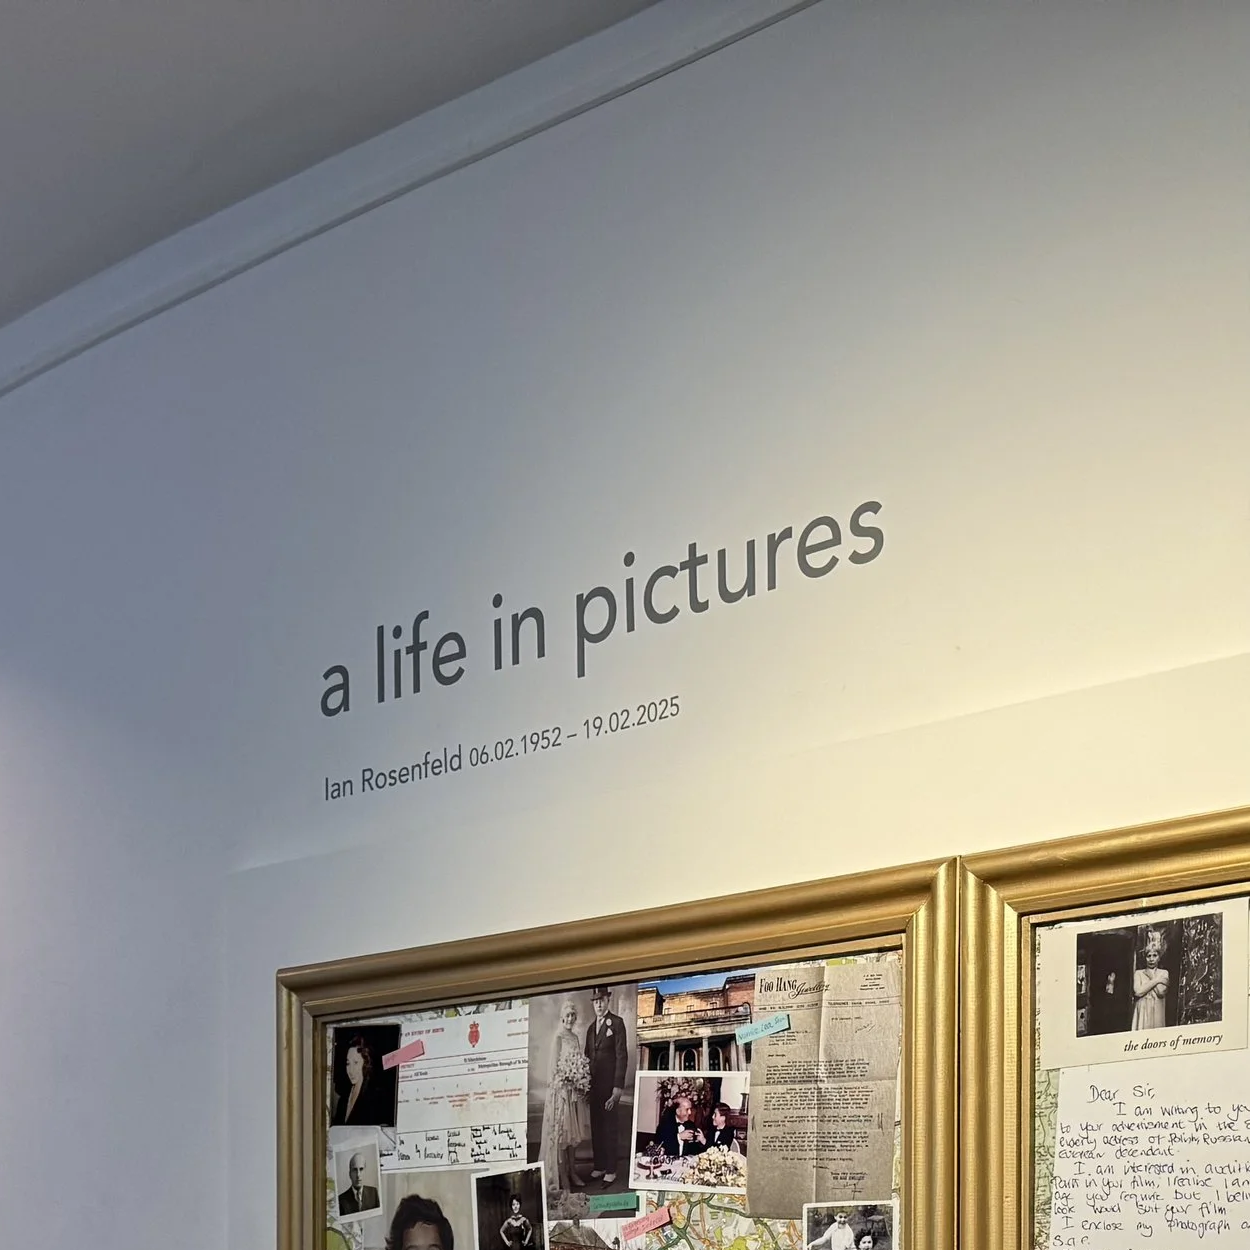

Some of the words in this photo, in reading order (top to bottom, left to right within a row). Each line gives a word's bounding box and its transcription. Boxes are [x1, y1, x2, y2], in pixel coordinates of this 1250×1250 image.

[321, 665, 349, 717] a
[377, 610, 466, 703] life
[493, 593, 545, 670] in
[576, 501, 884, 678] pictures
[326, 778, 353, 800] Ian
[362, 744, 462, 792] Rosenfeld
[470, 727, 561, 766] 06.02.1952
[584, 696, 679, 738] 19.02.2025
[1124, 1040, 1138, 1052] the
[1141, 1038, 1167, 1050] doors
[1170, 1035, 1182, 1050] of
[1183, 1034, 1223, 1045] memory
[1087, 1084, 1119, 1103] Dear
